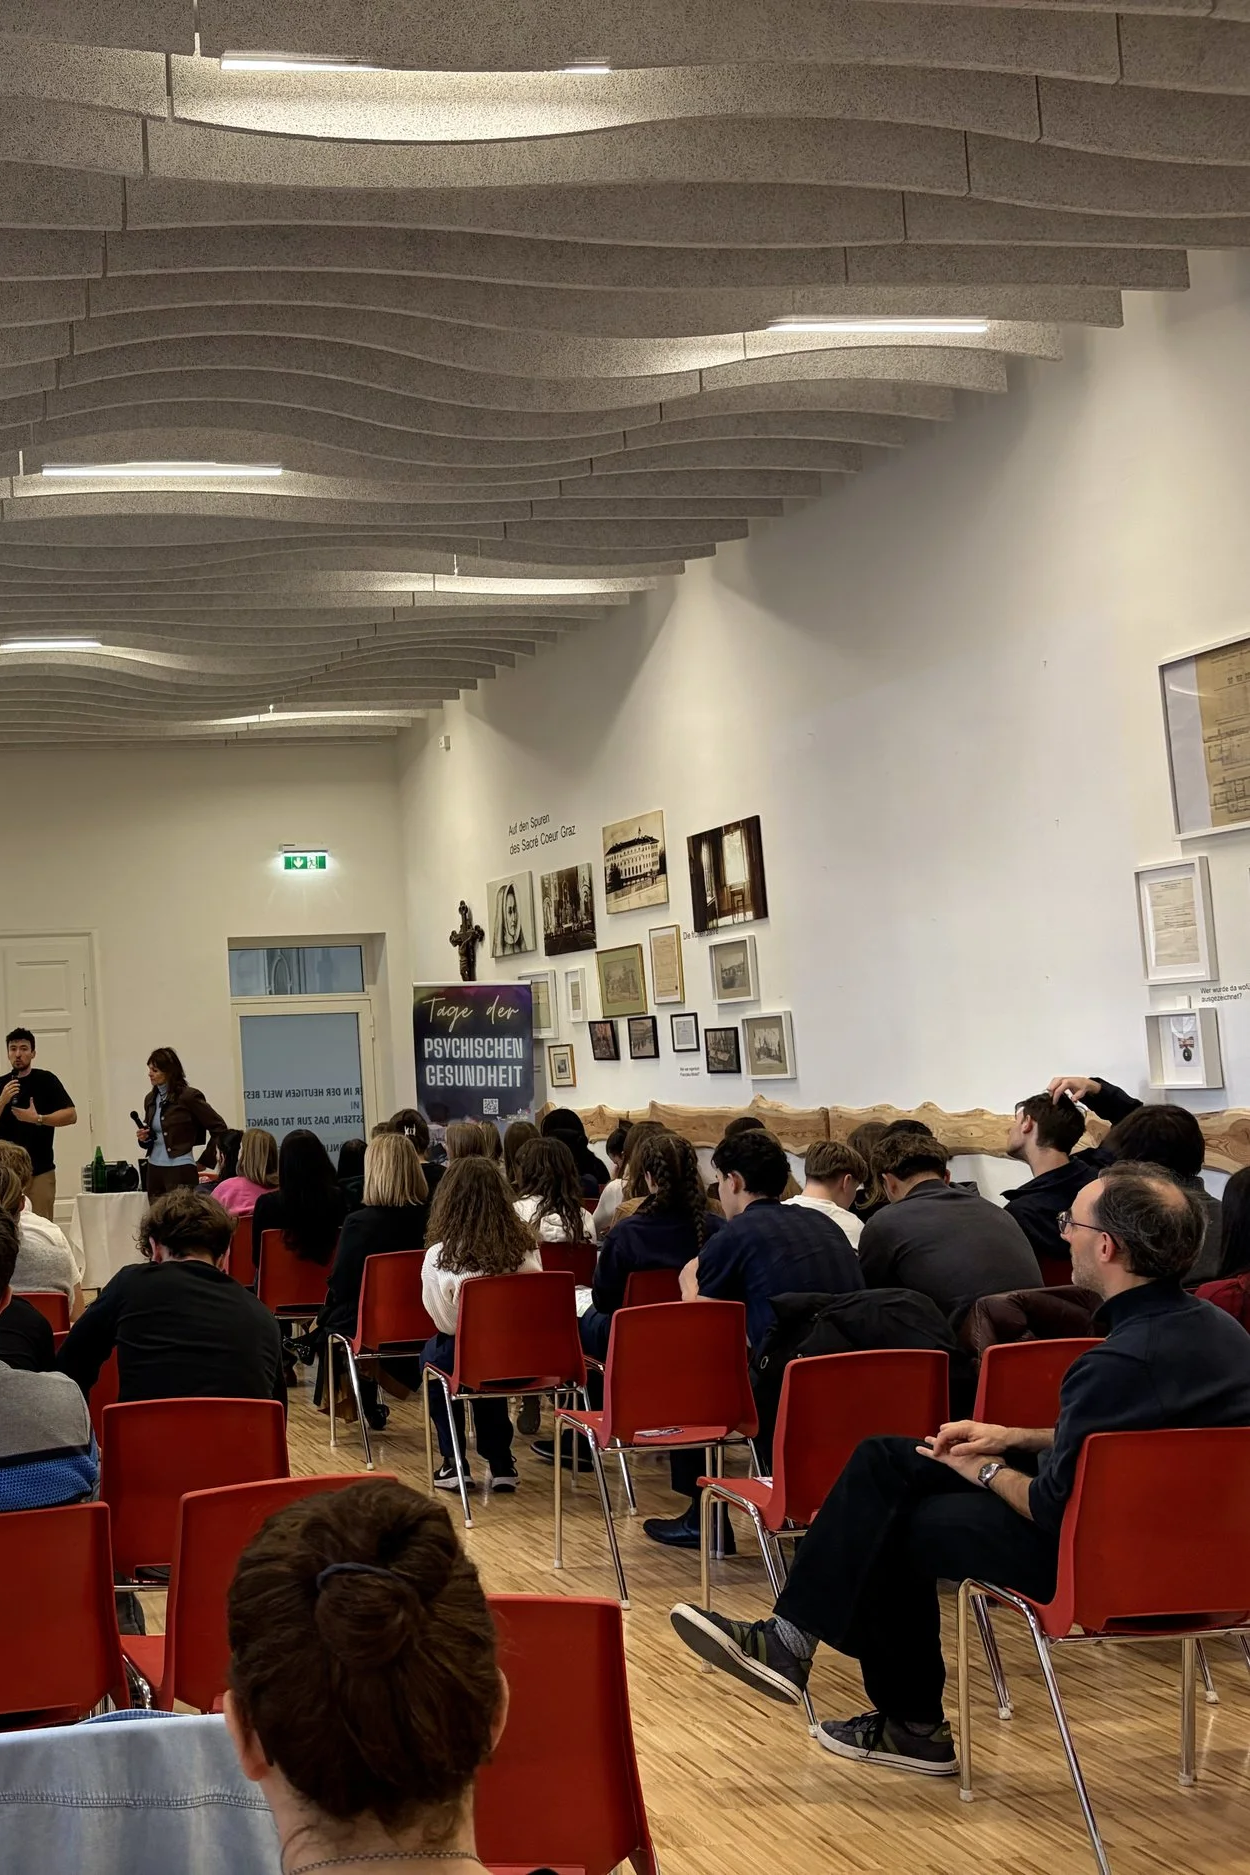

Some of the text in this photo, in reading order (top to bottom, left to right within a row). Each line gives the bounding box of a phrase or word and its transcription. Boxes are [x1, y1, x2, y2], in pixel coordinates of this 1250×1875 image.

[509, 814, 550, 836] Auf den Spuren
[510, 825, 576, 855] des Sacré Coeur Graz
[422, 994, 520, 1032] Tage der
[424, 1038, 524, 1058] PSYCHISCHEN
[425, 1064, 522, 1088] GESUNDHEIT
